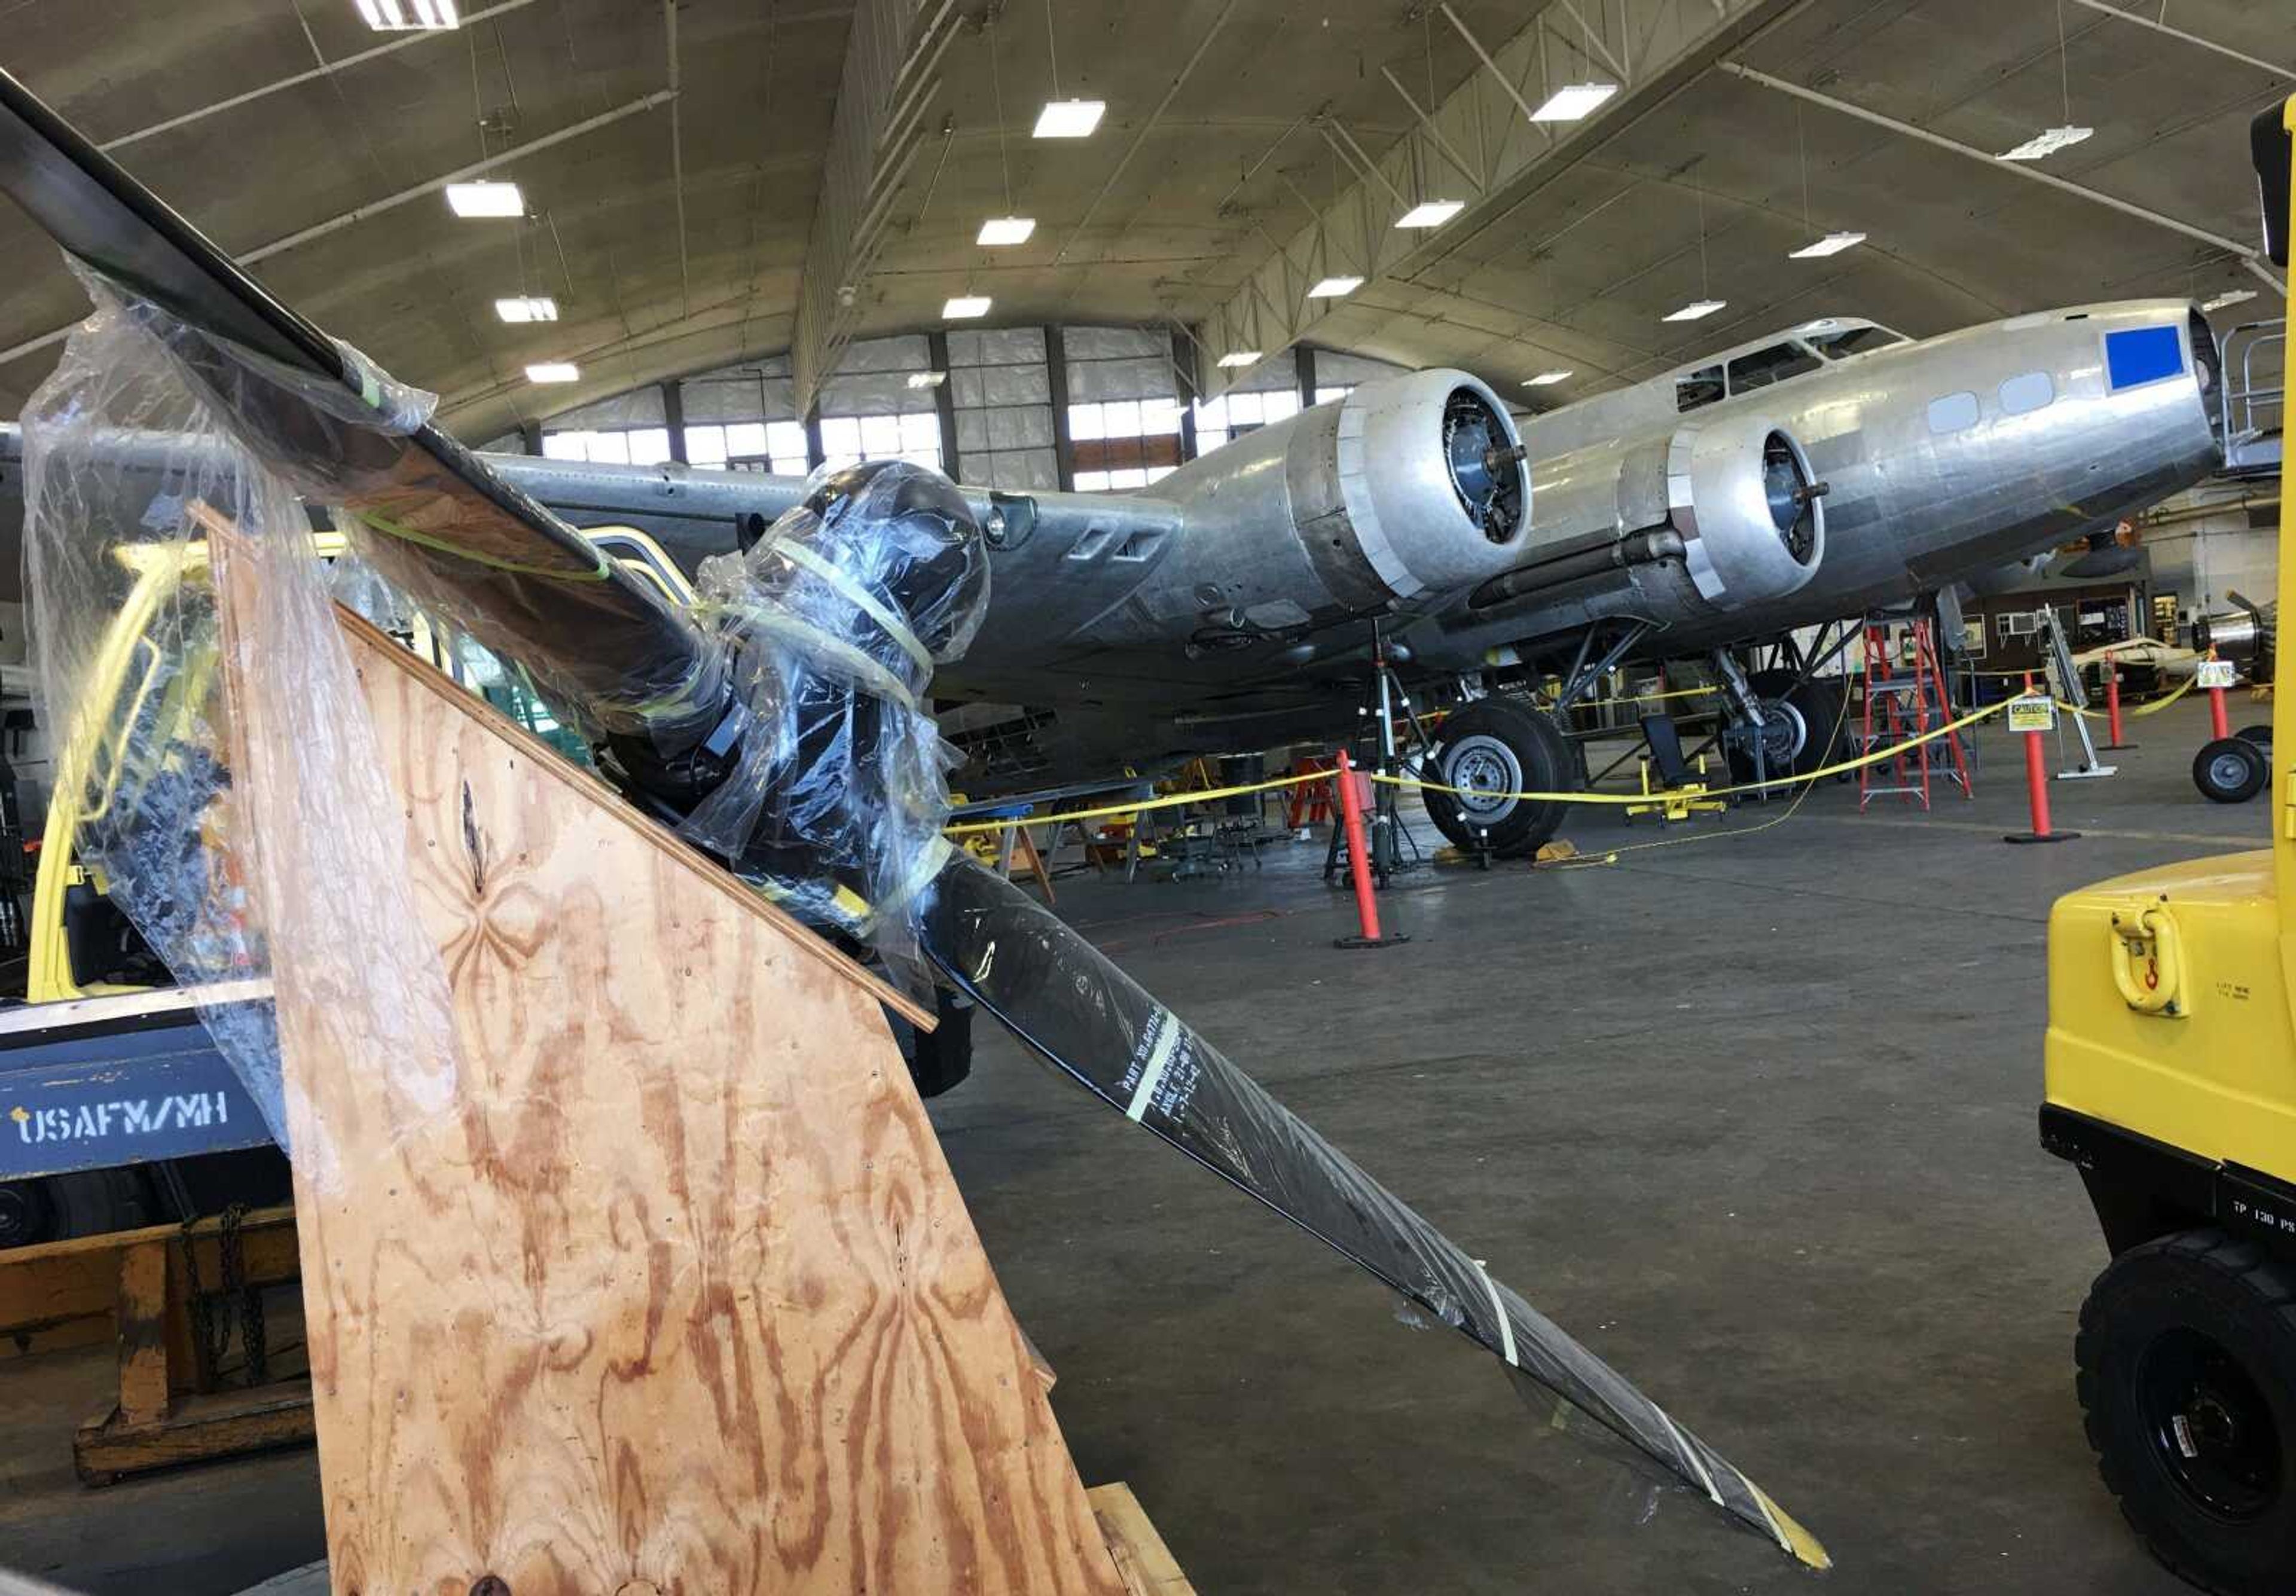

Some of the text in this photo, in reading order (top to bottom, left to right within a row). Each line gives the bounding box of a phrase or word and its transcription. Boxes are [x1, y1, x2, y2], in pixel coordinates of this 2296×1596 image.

[1123, 1061, 1141, 1092] PART
[19, 1091, 227, 1143] USAFM/MH
[2234, 1201, 2246, 1213] TP
[2255, 1209, 2274, 1225] 130
